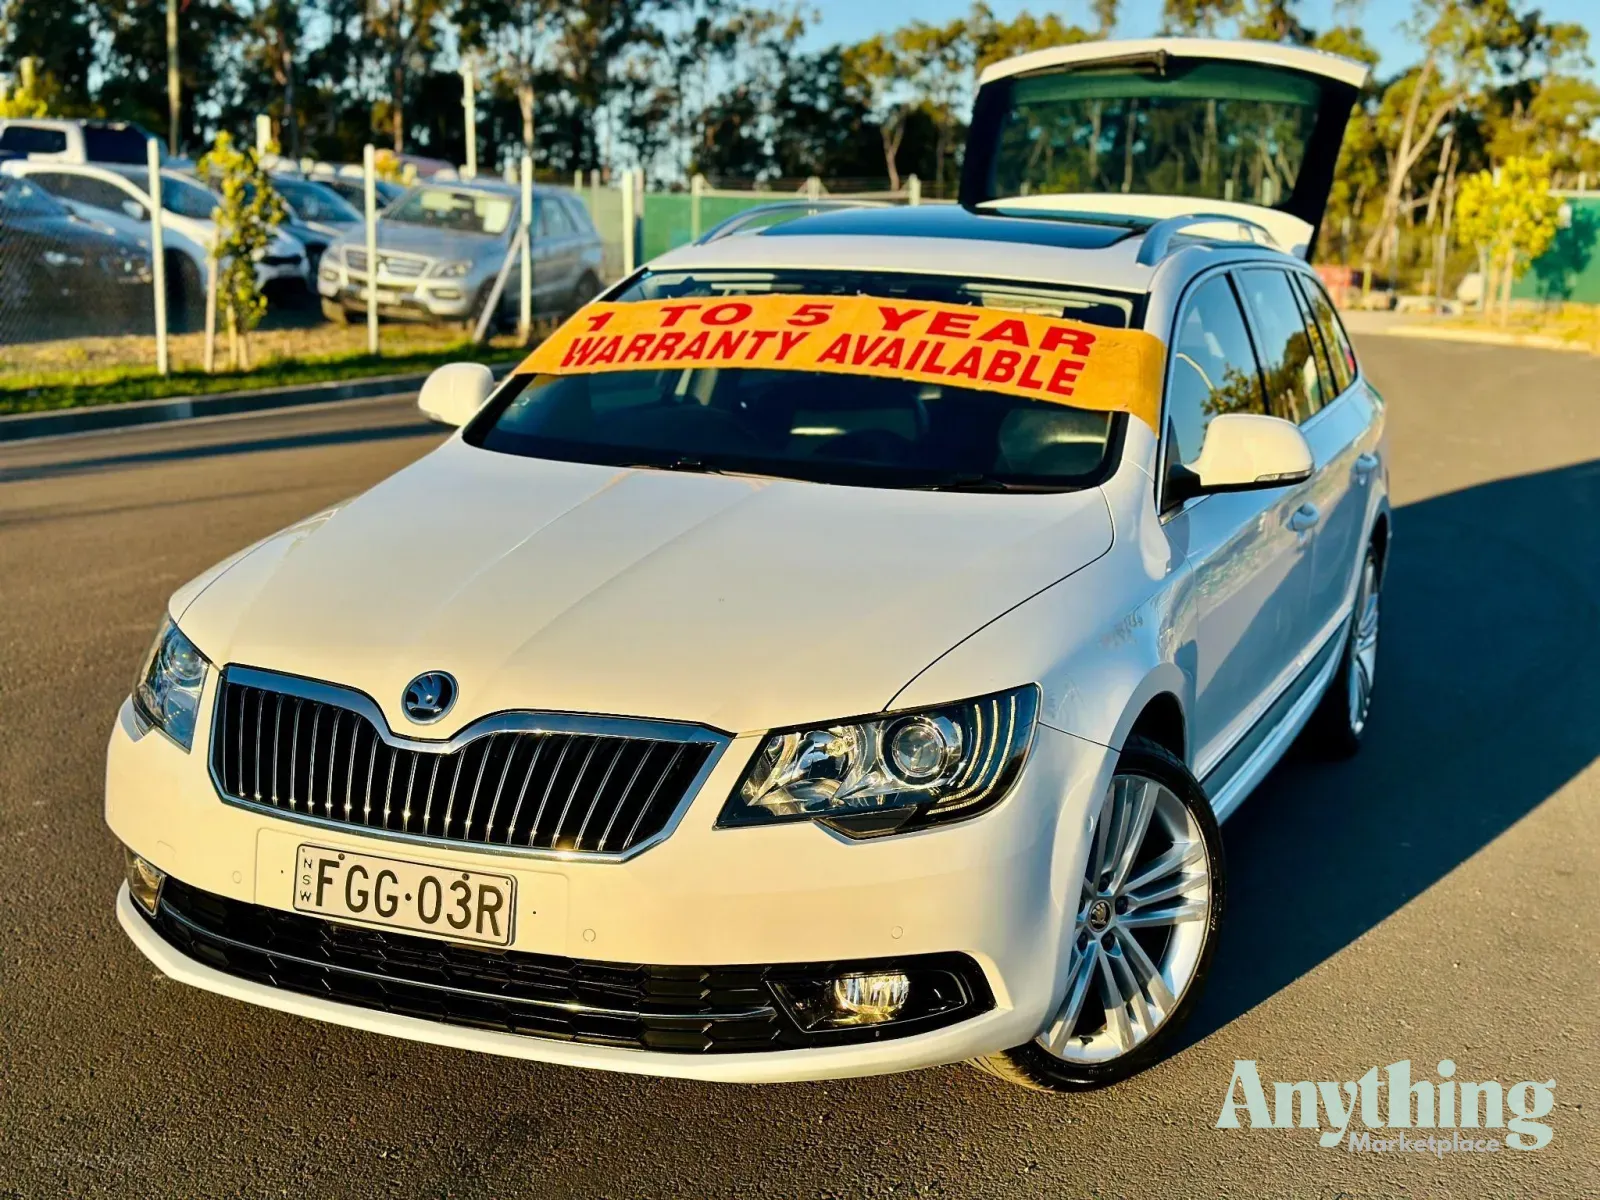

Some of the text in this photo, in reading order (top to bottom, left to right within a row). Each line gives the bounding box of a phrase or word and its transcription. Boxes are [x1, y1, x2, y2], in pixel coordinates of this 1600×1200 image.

[586, 302, 1097, 358] 1 TO 5 YEAR
[559, 330, 1086, 396] WARRANTY AVAILABLE
[299, 857, 313, 903] NSW
